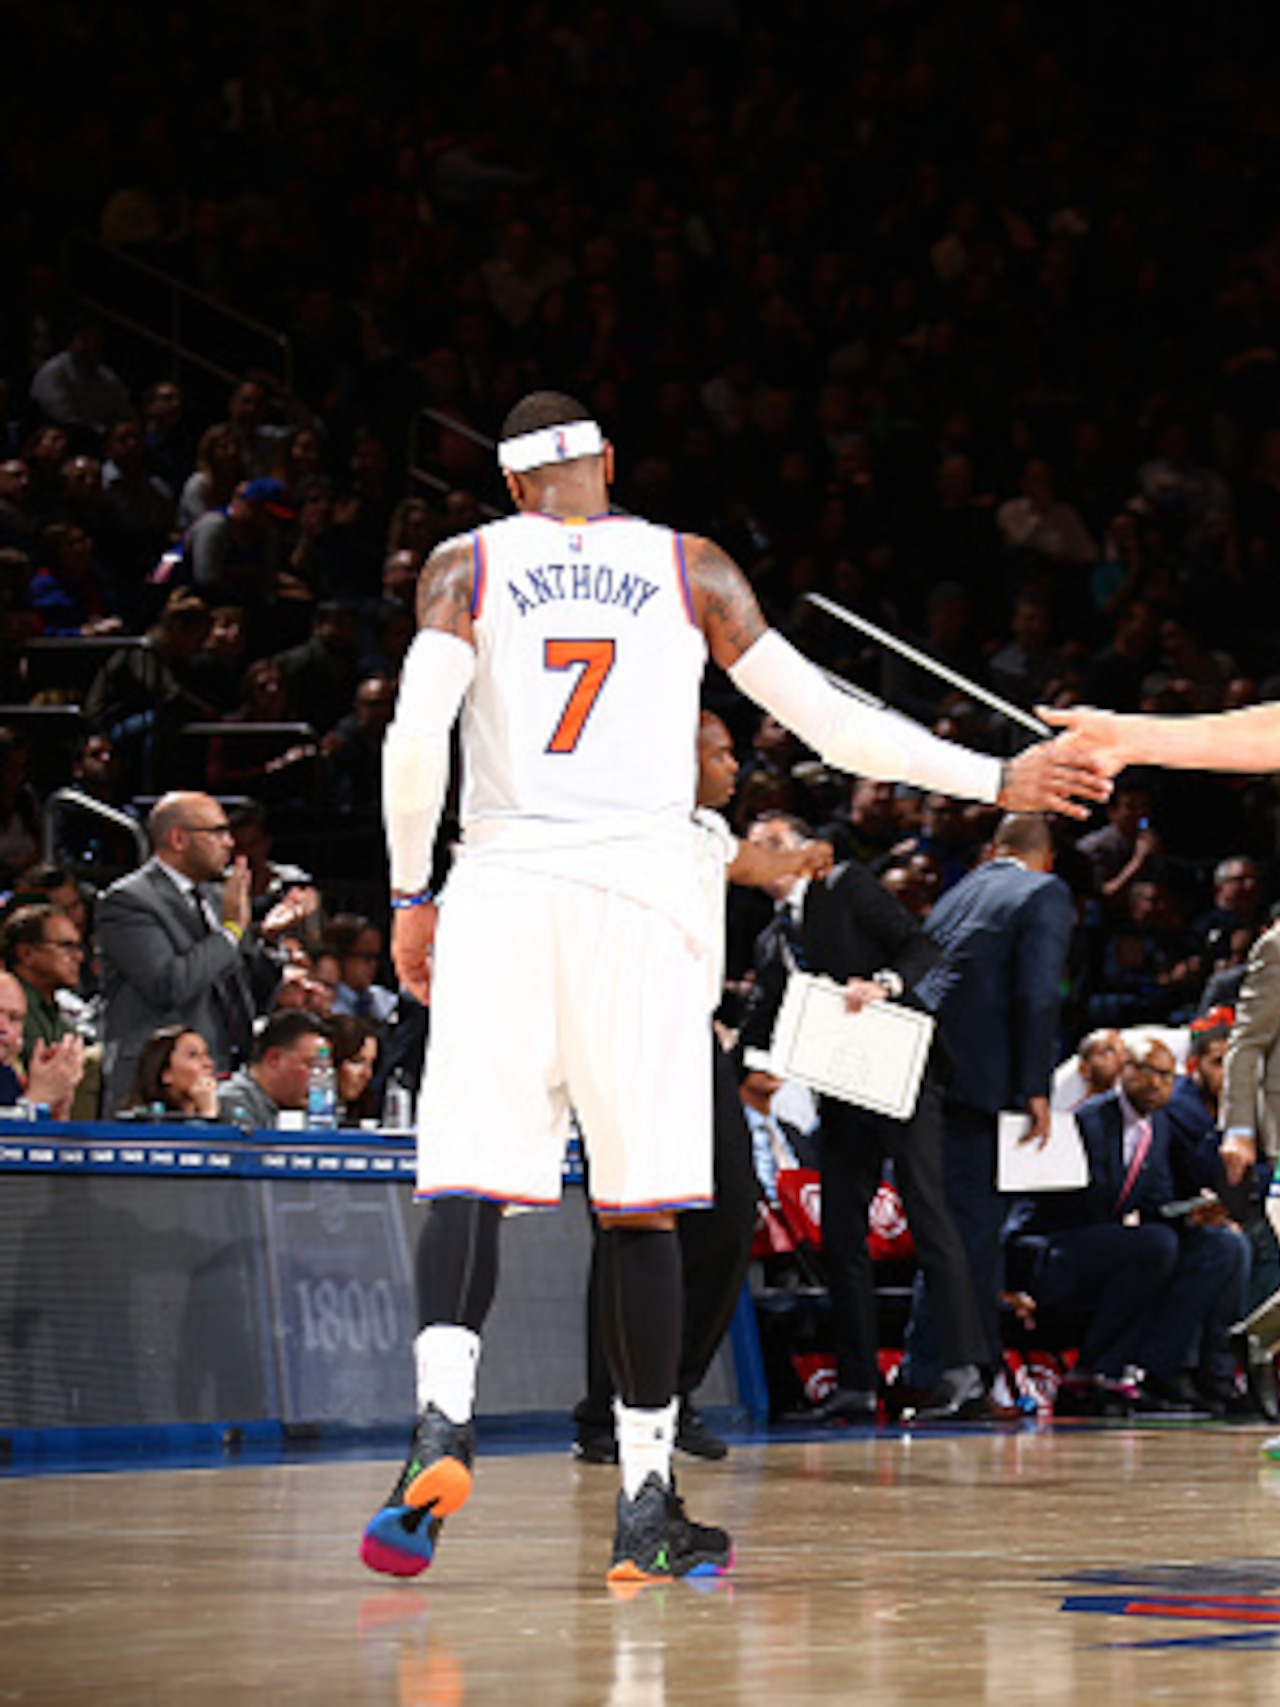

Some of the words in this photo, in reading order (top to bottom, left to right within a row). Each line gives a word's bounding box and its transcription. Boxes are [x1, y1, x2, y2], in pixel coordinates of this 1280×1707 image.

[508, 564, 660, 617] ANTHONY
[543, 638, 616, 754] 7
[295, 1278, 398, 1351] 1800
